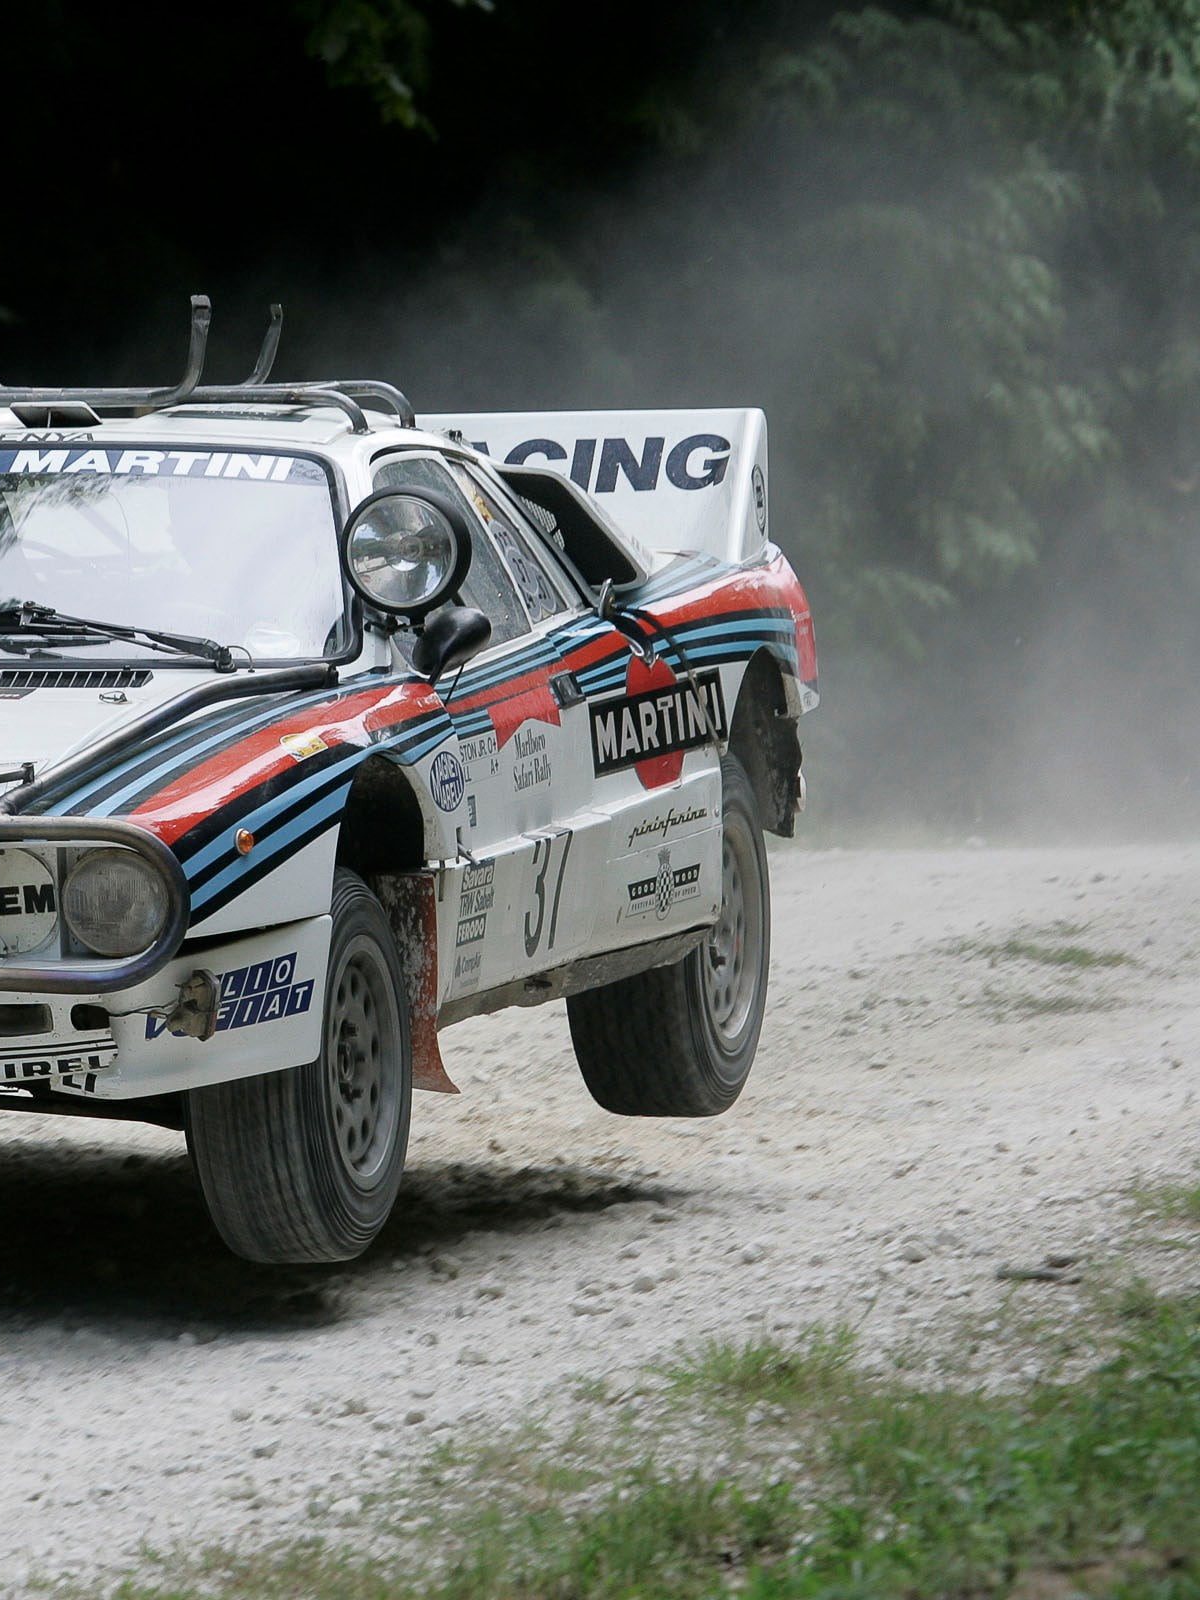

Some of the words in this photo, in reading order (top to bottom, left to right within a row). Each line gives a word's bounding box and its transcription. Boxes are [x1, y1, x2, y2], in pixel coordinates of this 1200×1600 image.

[10, 450, 293, 481] MARTINI
[595, 682, 722, 764] MARTINI
[514, 729, 546, 760] Marlboro
[513, 762, 533, 792] Safari
[534, 754, 552, 786] Rally
[628, 806, 708, 847] pininfarina
[521, 828, 572, 957] 37
[457, 917, 484, 944] FERODO
[223, 959, 291, 997] LIO
